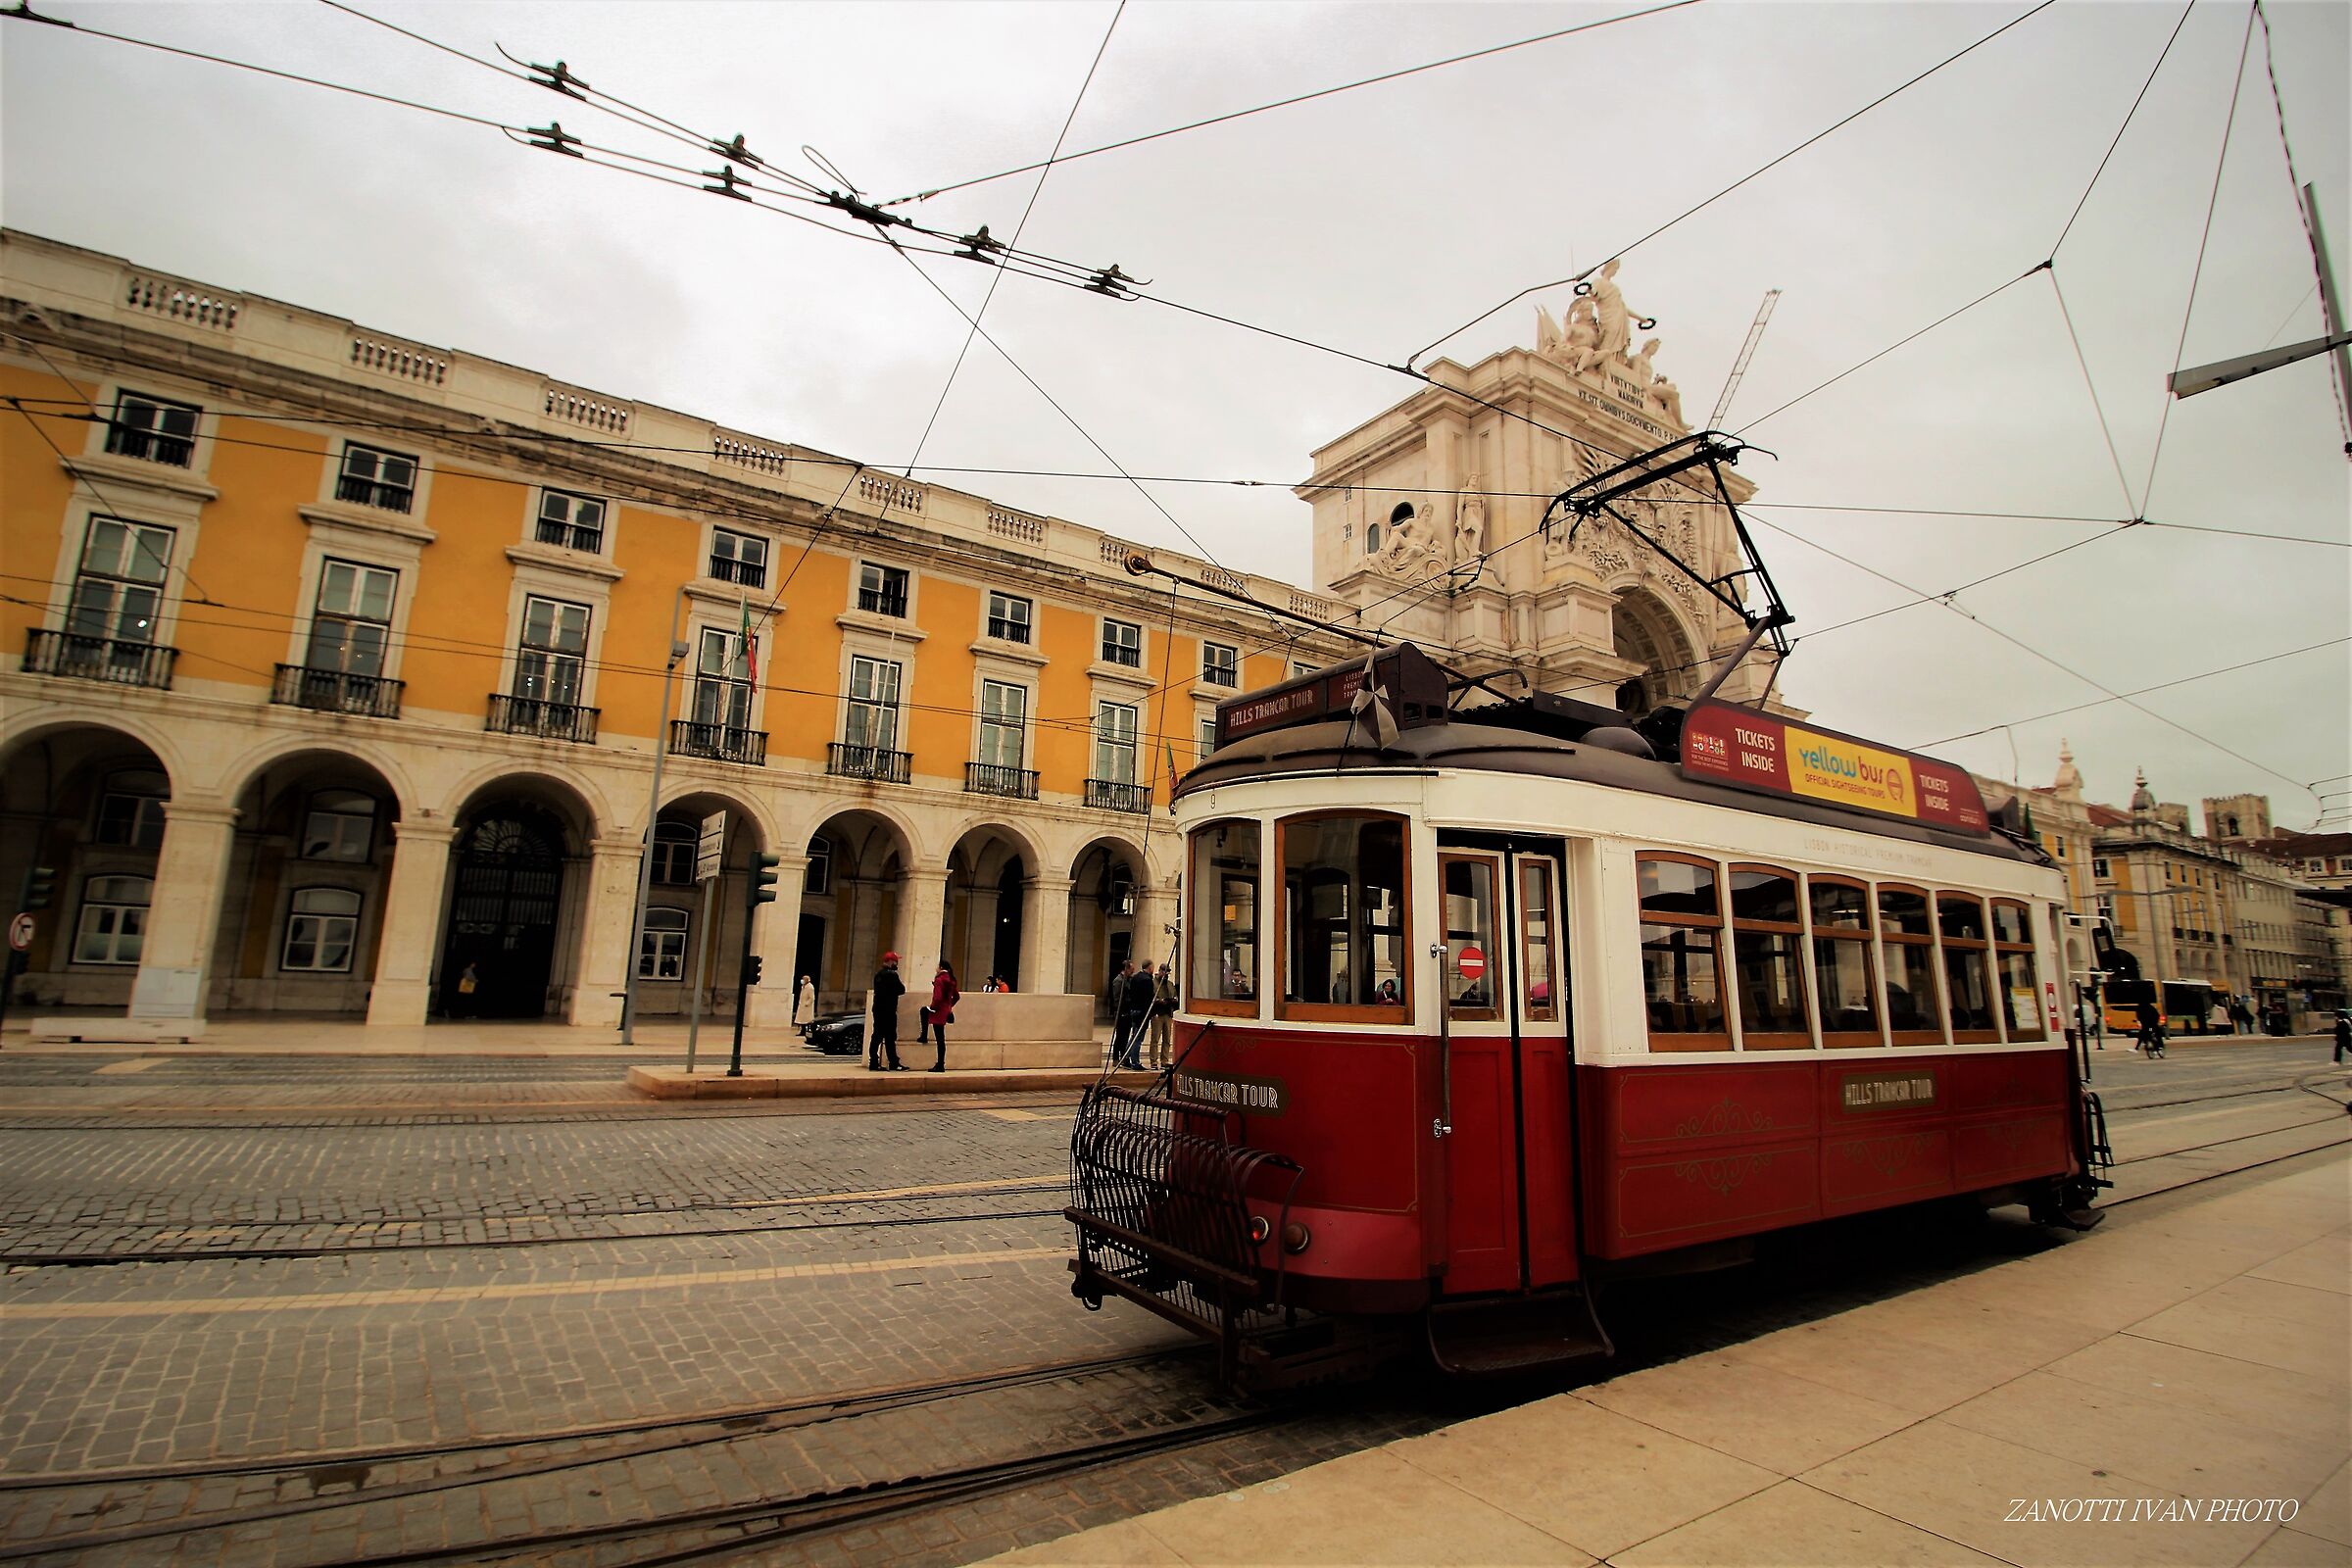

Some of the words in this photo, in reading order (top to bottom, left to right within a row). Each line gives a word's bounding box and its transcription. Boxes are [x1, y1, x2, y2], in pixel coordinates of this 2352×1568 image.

[1230, 708, 1253, 727] HILLS
[1292, 689, 1314, 710] TOUR
[1735, 727, 1776, 752] TICKETS
[1740, 751, 1775, 773] INSIDE
[1858, 756, 1884, 784] bus
[1805, 773, 1831, 788] OFFICIAL
[1831, 779, 1867, 795] SIGHTSEEING
[1919, 774, 1950, 793] TICKETS
[1195, 1078, 1239, 1104] TRAMCAR
[1241, 1084, 1279, 1108] TOUR
[1845, 1082, 1873, 1105] HILLS
[1911, 1078, 1933, 1100] TOUR
